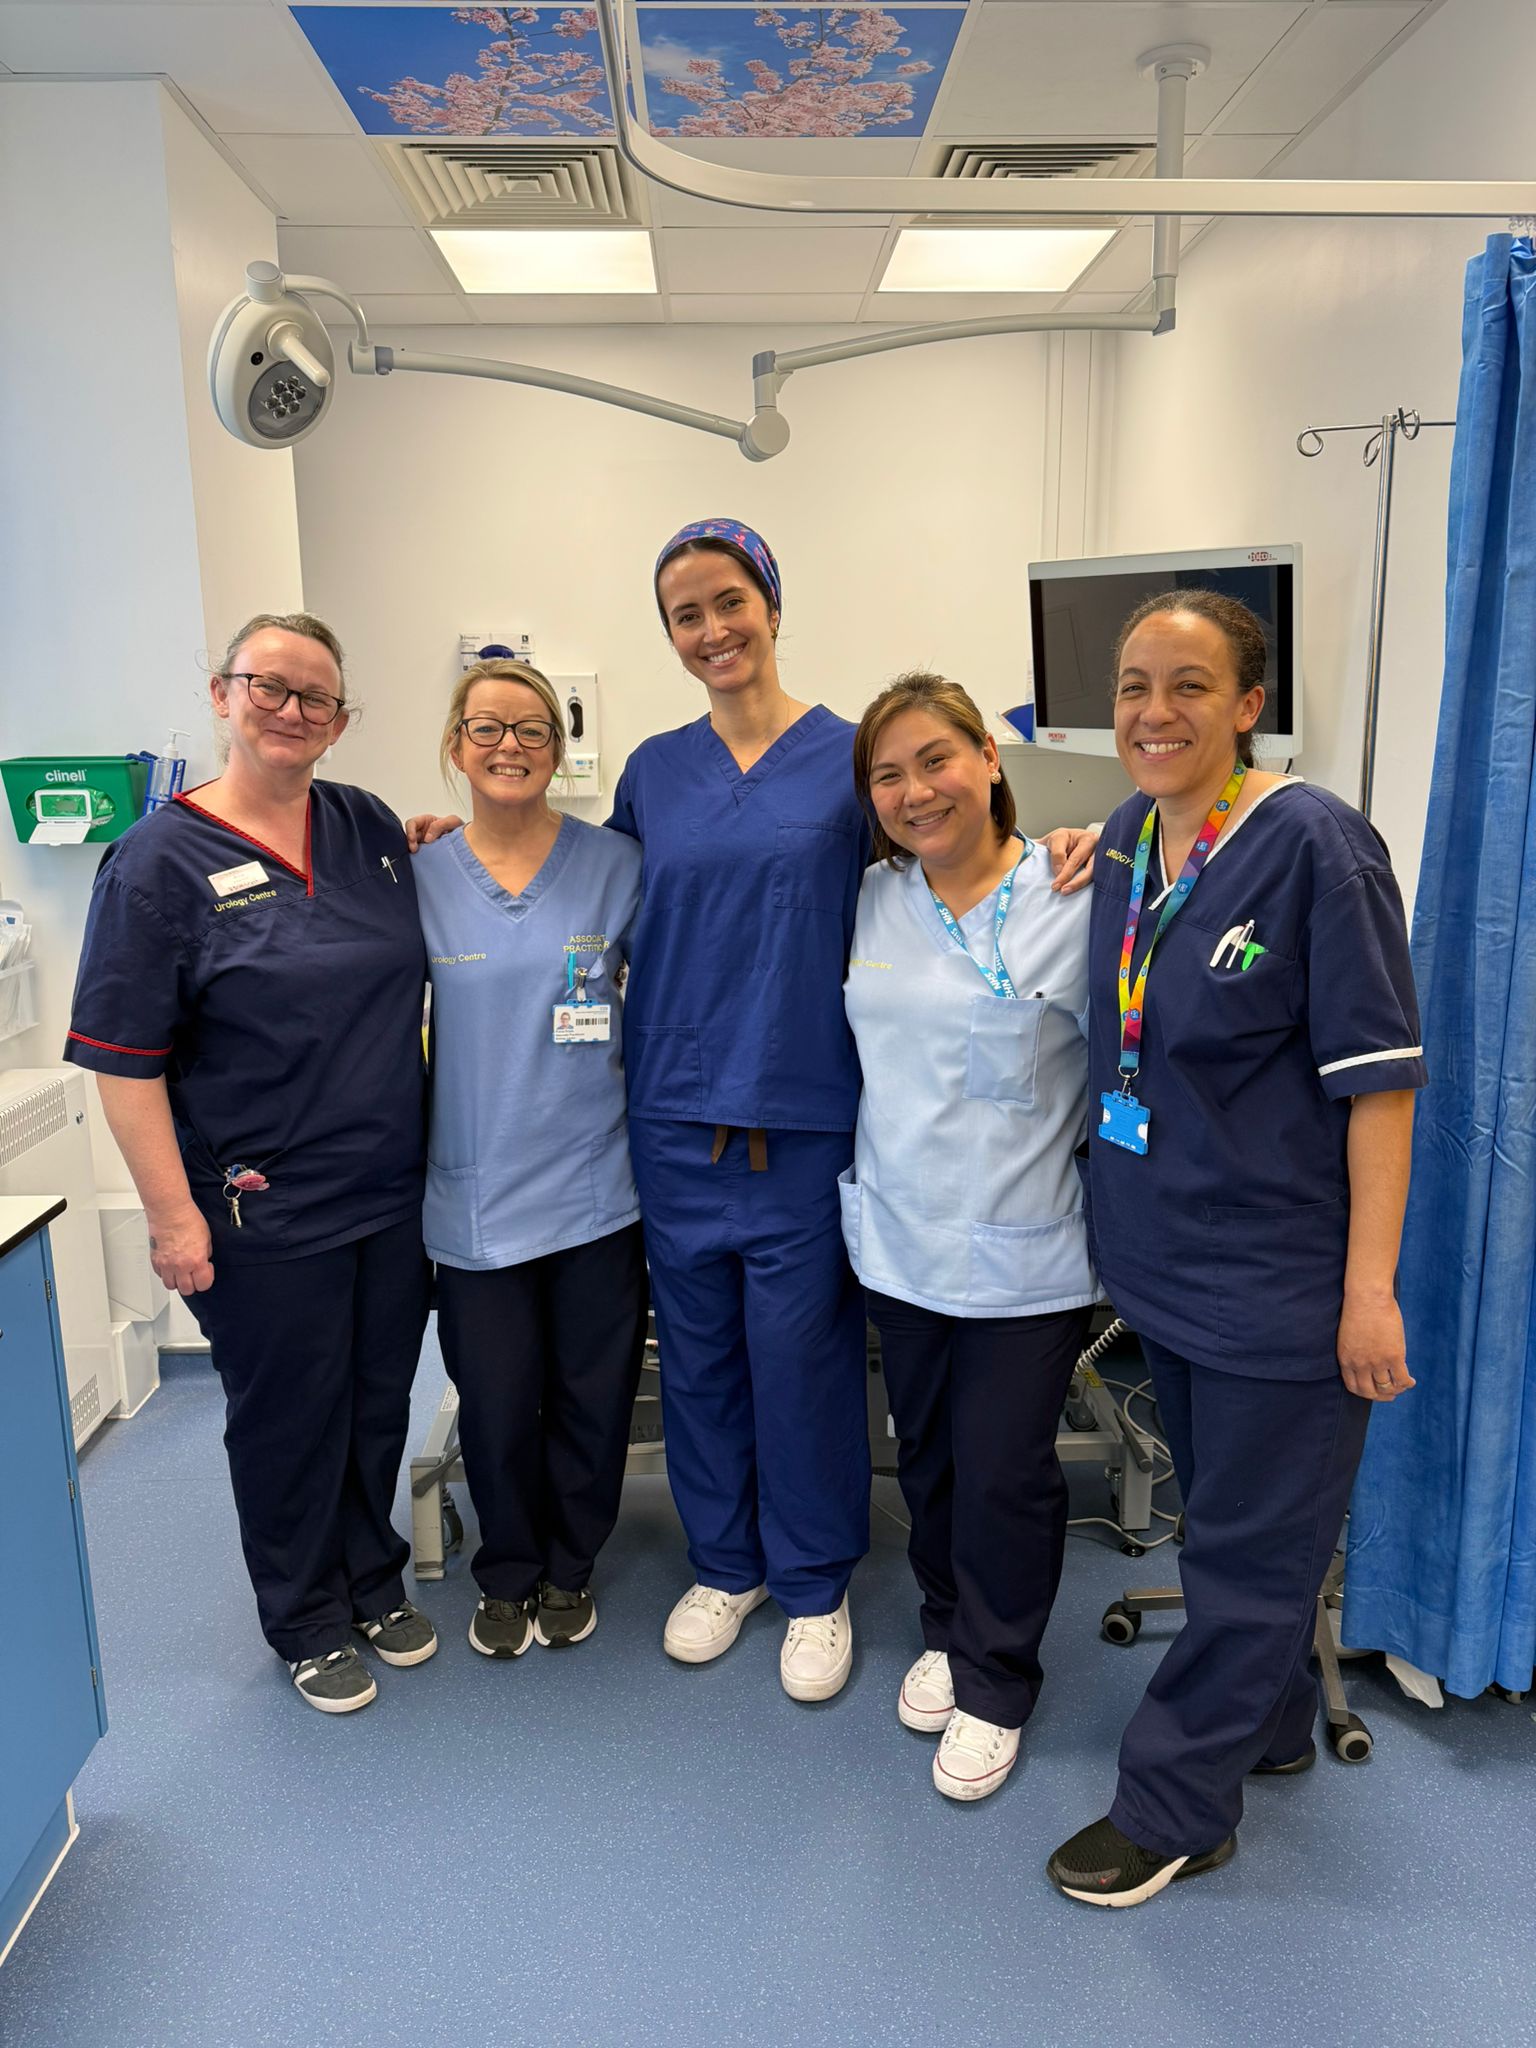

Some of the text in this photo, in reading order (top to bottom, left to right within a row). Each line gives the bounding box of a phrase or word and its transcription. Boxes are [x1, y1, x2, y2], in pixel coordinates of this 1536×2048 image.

[46, 769, 87, 782] clinell
[214, 890, 277, 912] Urology Centre
[999, 893, 1011, 912] NHS
[939, 907, 954, 925] NHS
[458, 953, 487, 962] Centre
[984, 971, 1002, 990] NHS
